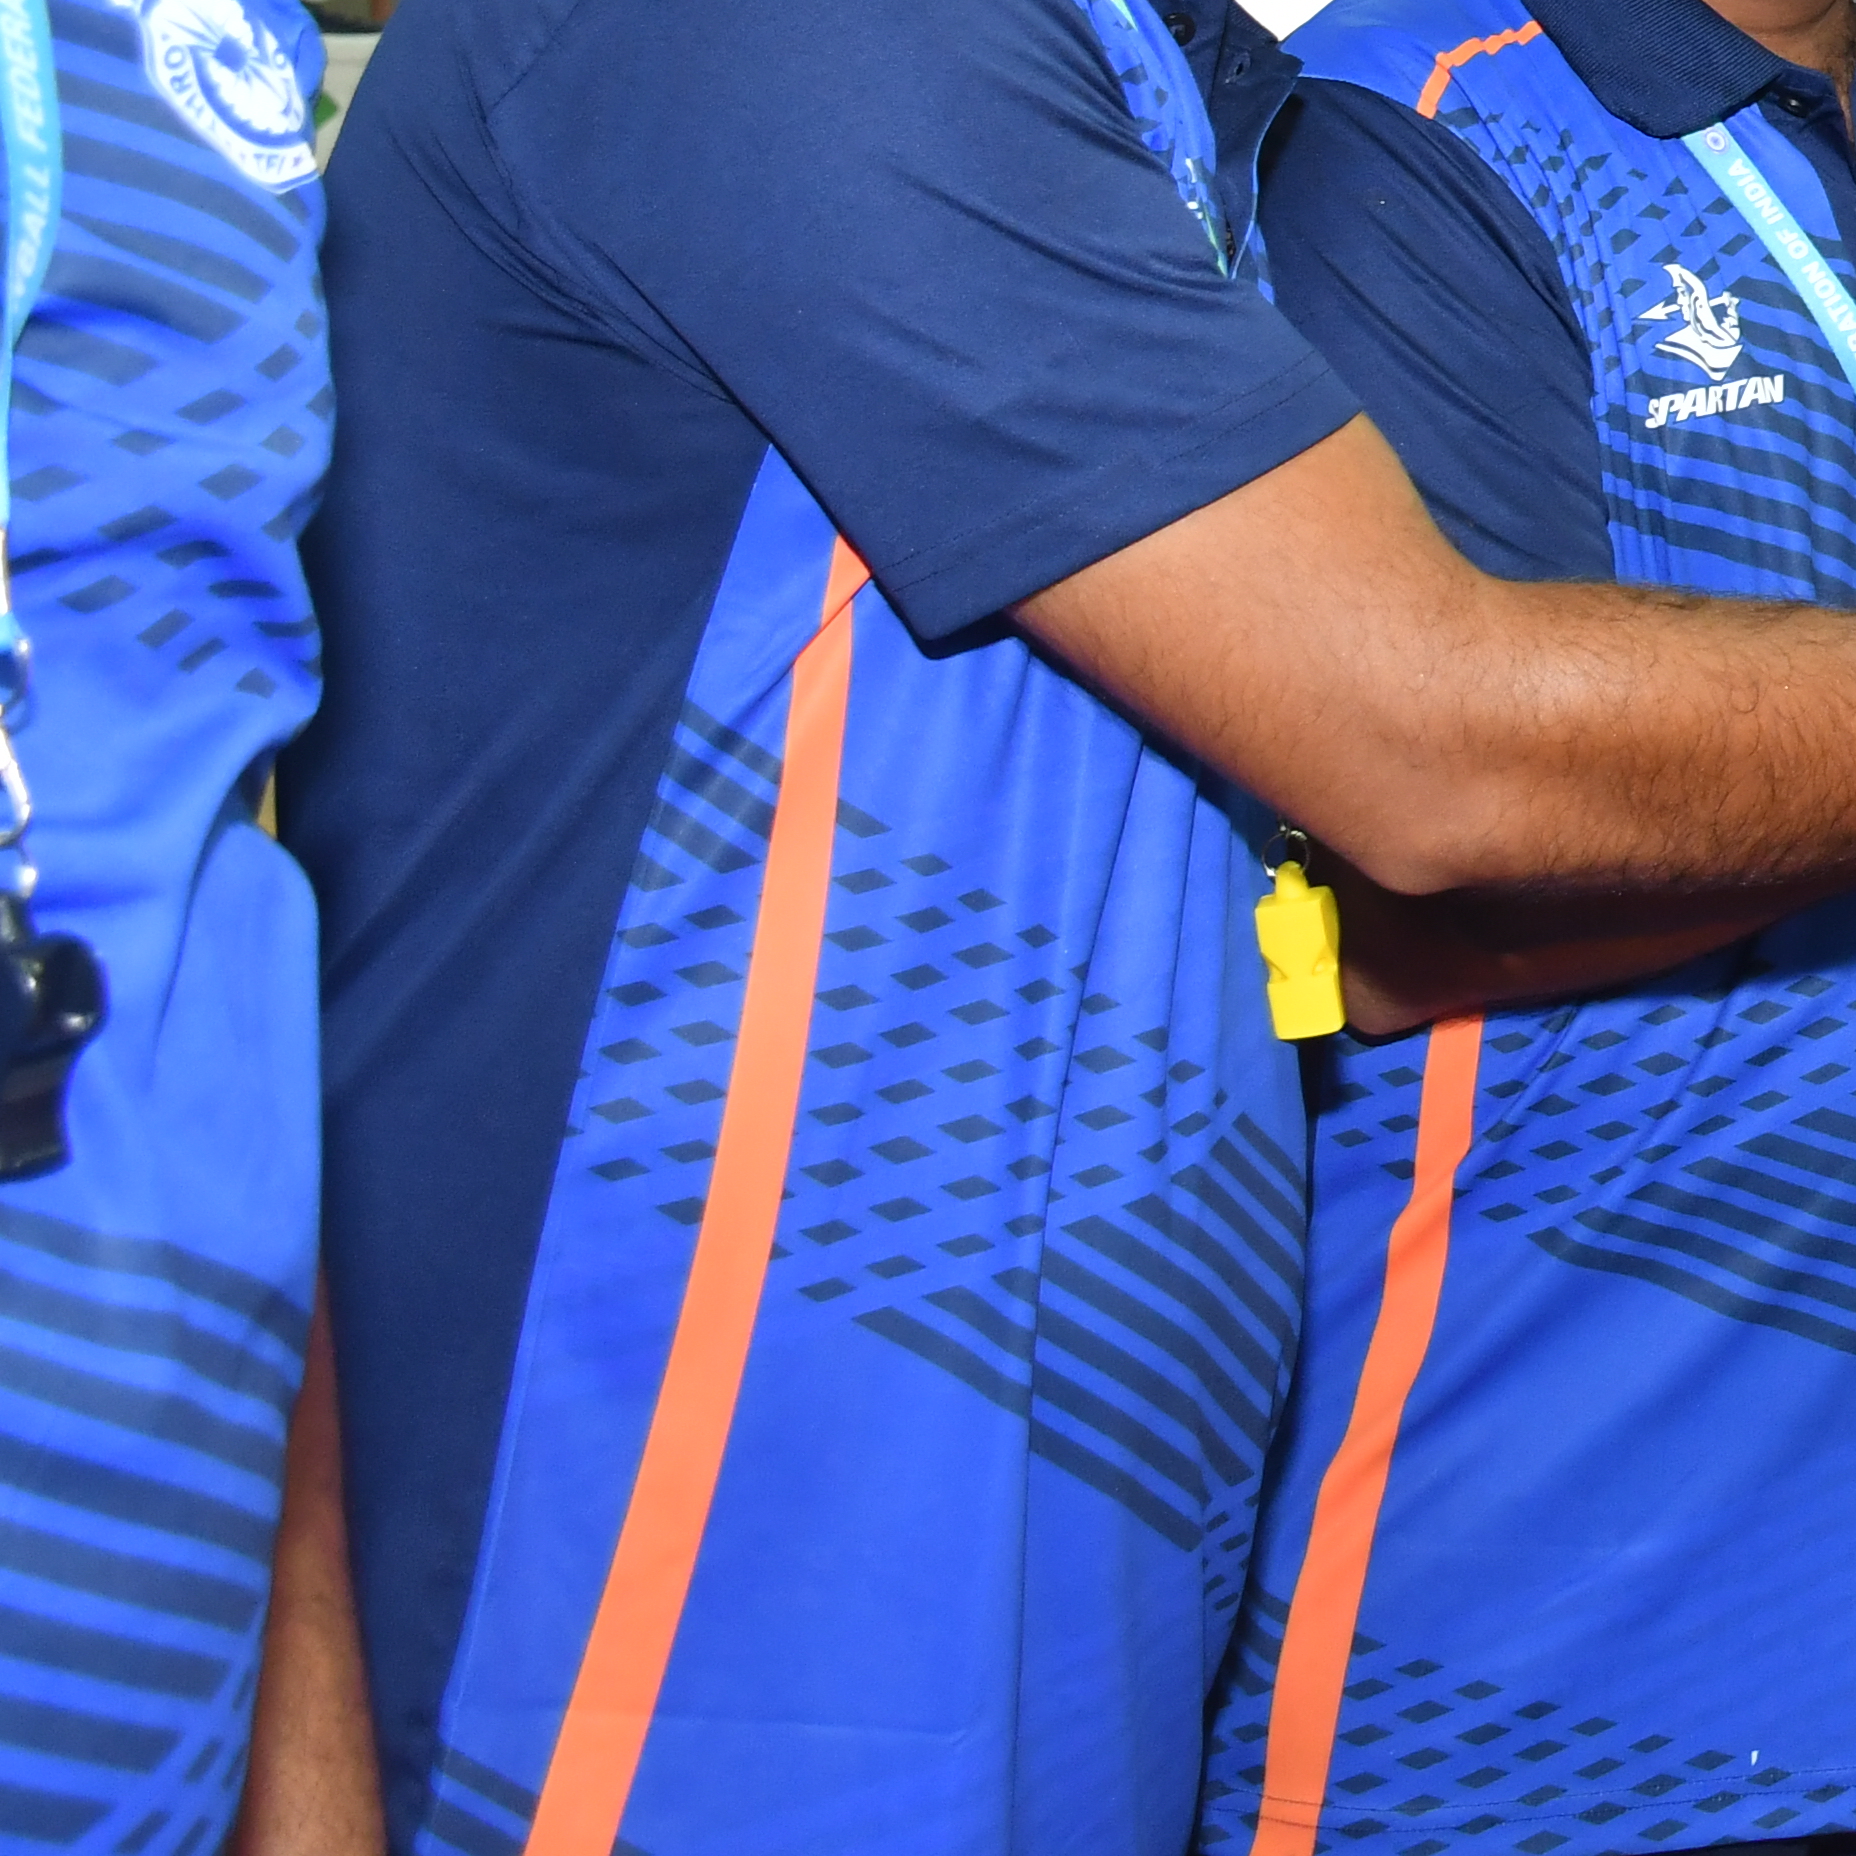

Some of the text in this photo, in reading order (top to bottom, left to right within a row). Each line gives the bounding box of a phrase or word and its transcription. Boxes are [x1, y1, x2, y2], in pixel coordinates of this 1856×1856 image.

[1727, 158, 1785, 225] INDIA
[1775, 228, 1809, 260] OF
[1644, 373, 1785, 429] SPARTAN
